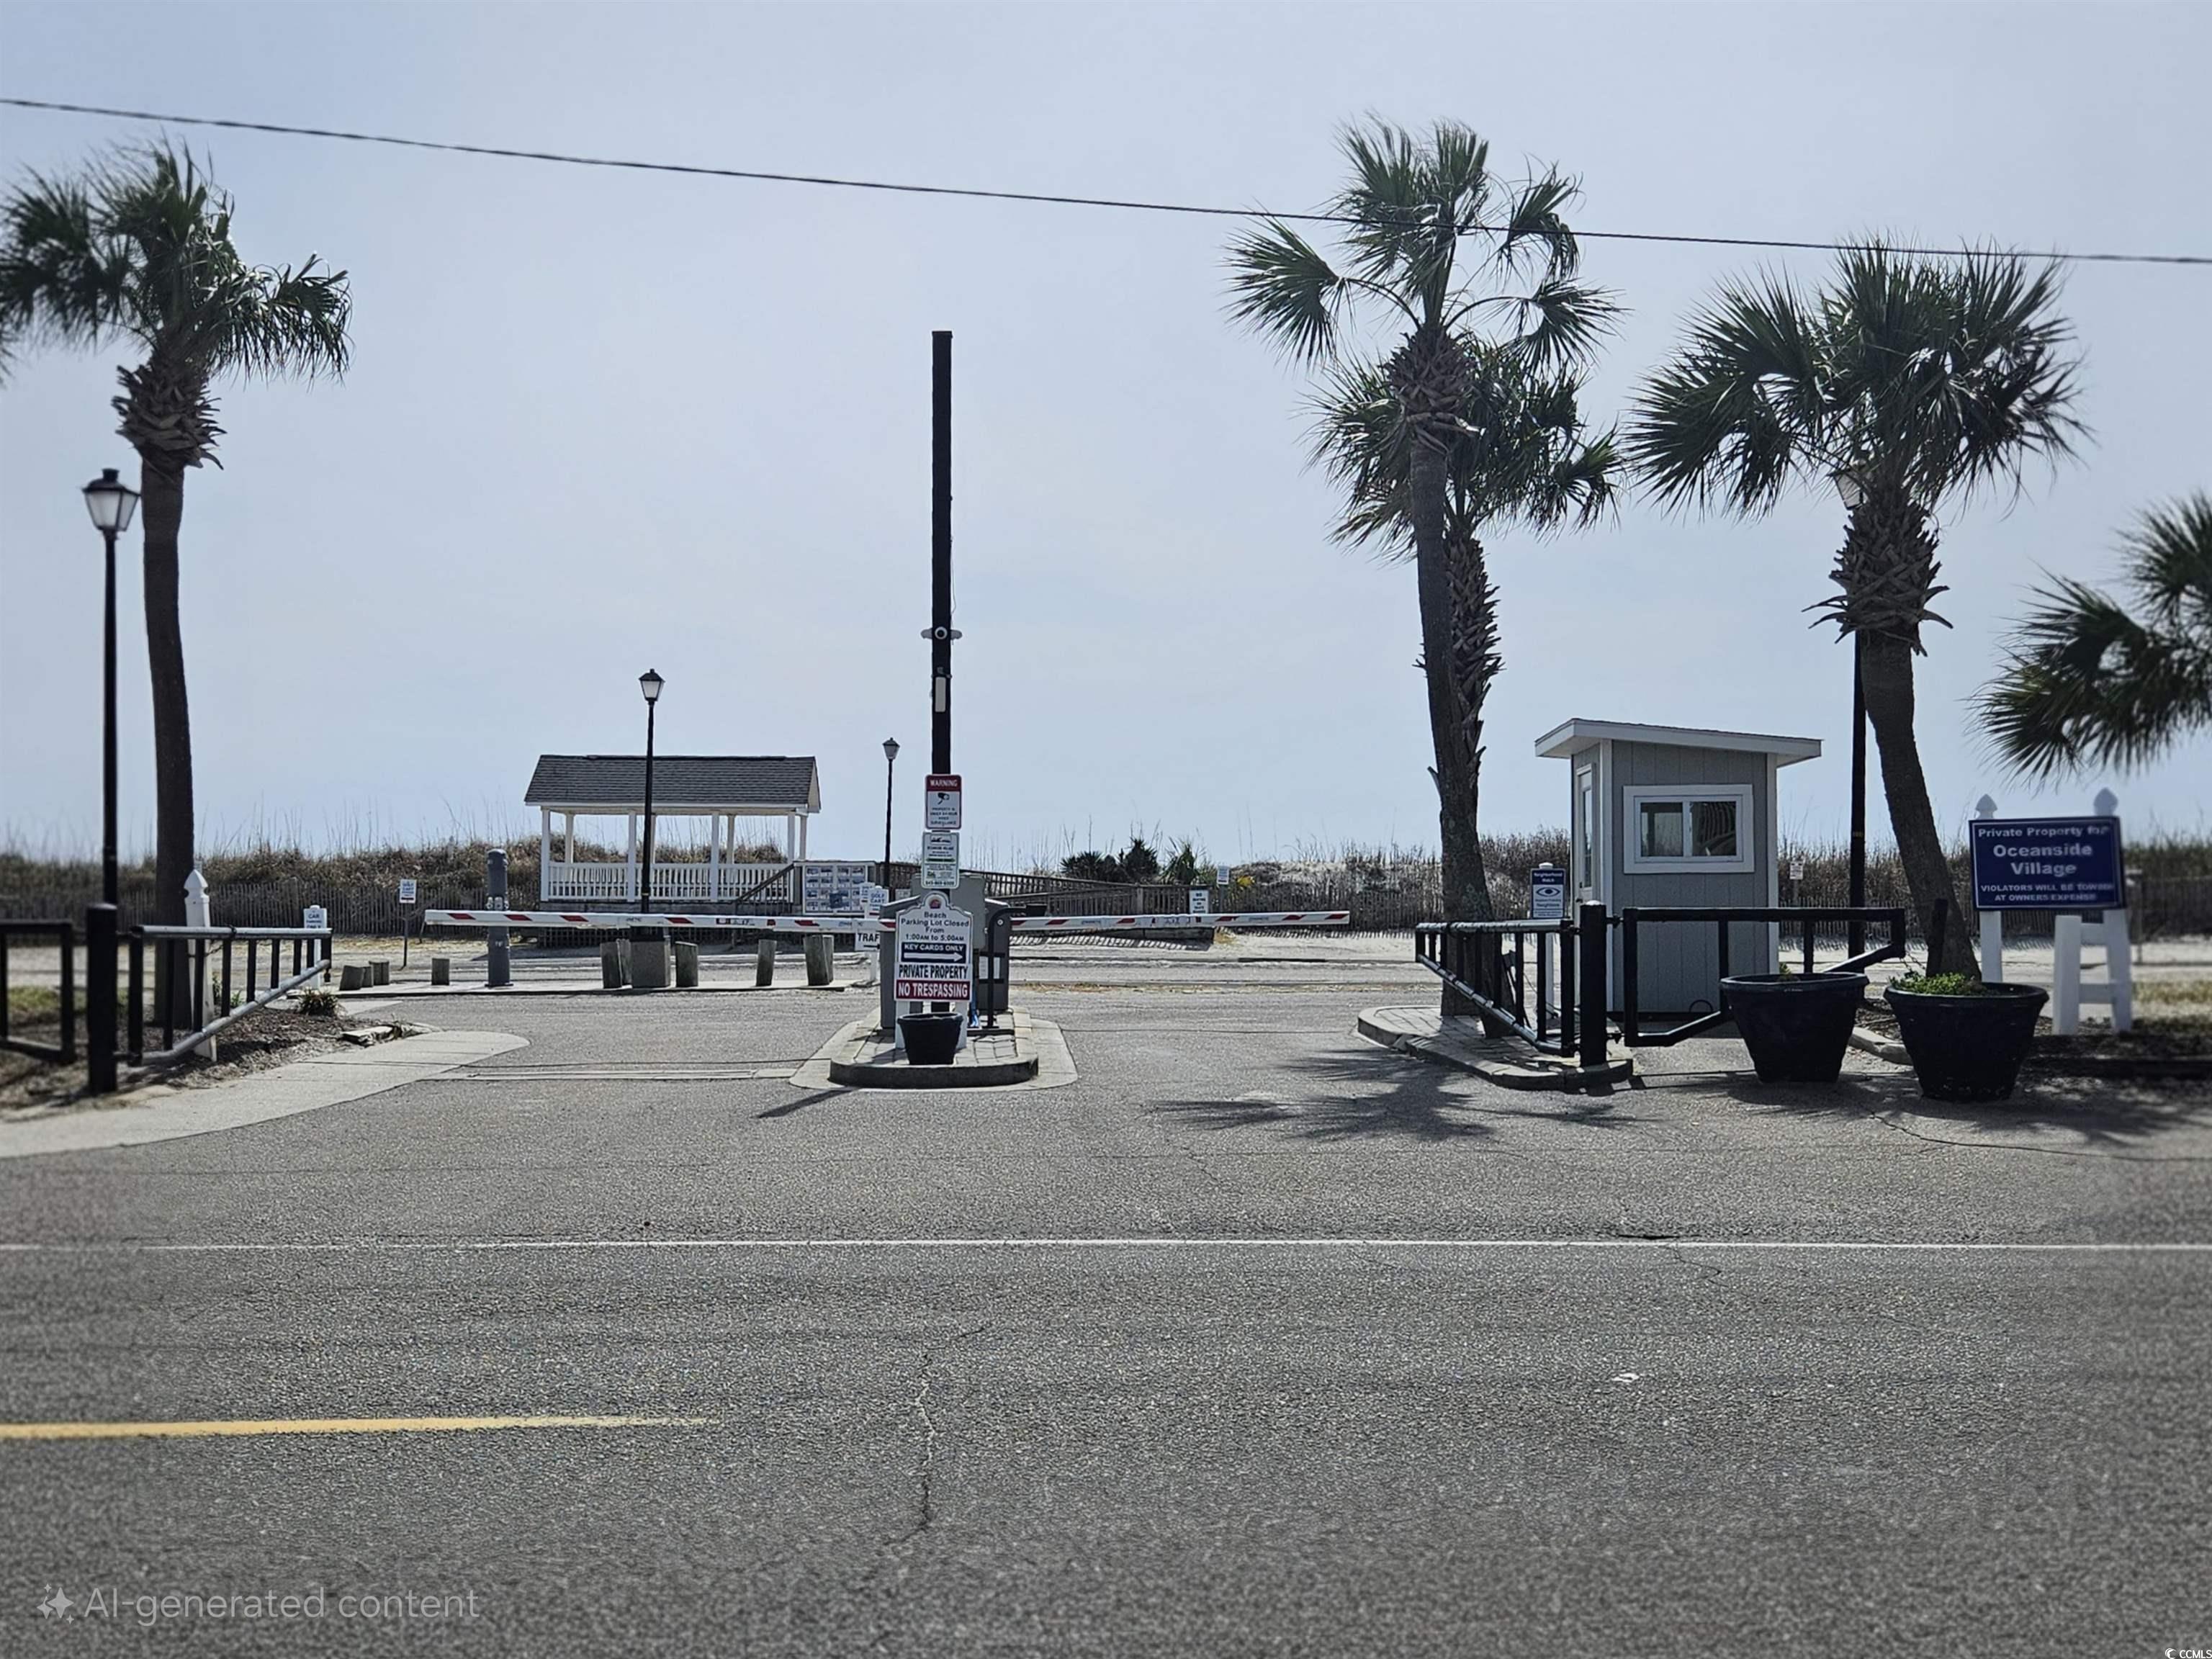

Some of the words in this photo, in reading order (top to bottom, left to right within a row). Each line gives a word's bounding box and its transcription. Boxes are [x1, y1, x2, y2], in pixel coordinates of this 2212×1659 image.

[1978, 828, 2023, 837] Private
[2027, 826, 2083, 837] Property
[1993, 843, 2092, 857] Oceanside
[2010, 862, 2077, 877] Village
[901, 918, 928, 927] Parking
[899, 965, 930, 979] PRIVATE
[930, 966, 968, 979] PROPERTY
[898, 982, 911, 997] NO
[912, 983, 968, 997] TRESPASSING
